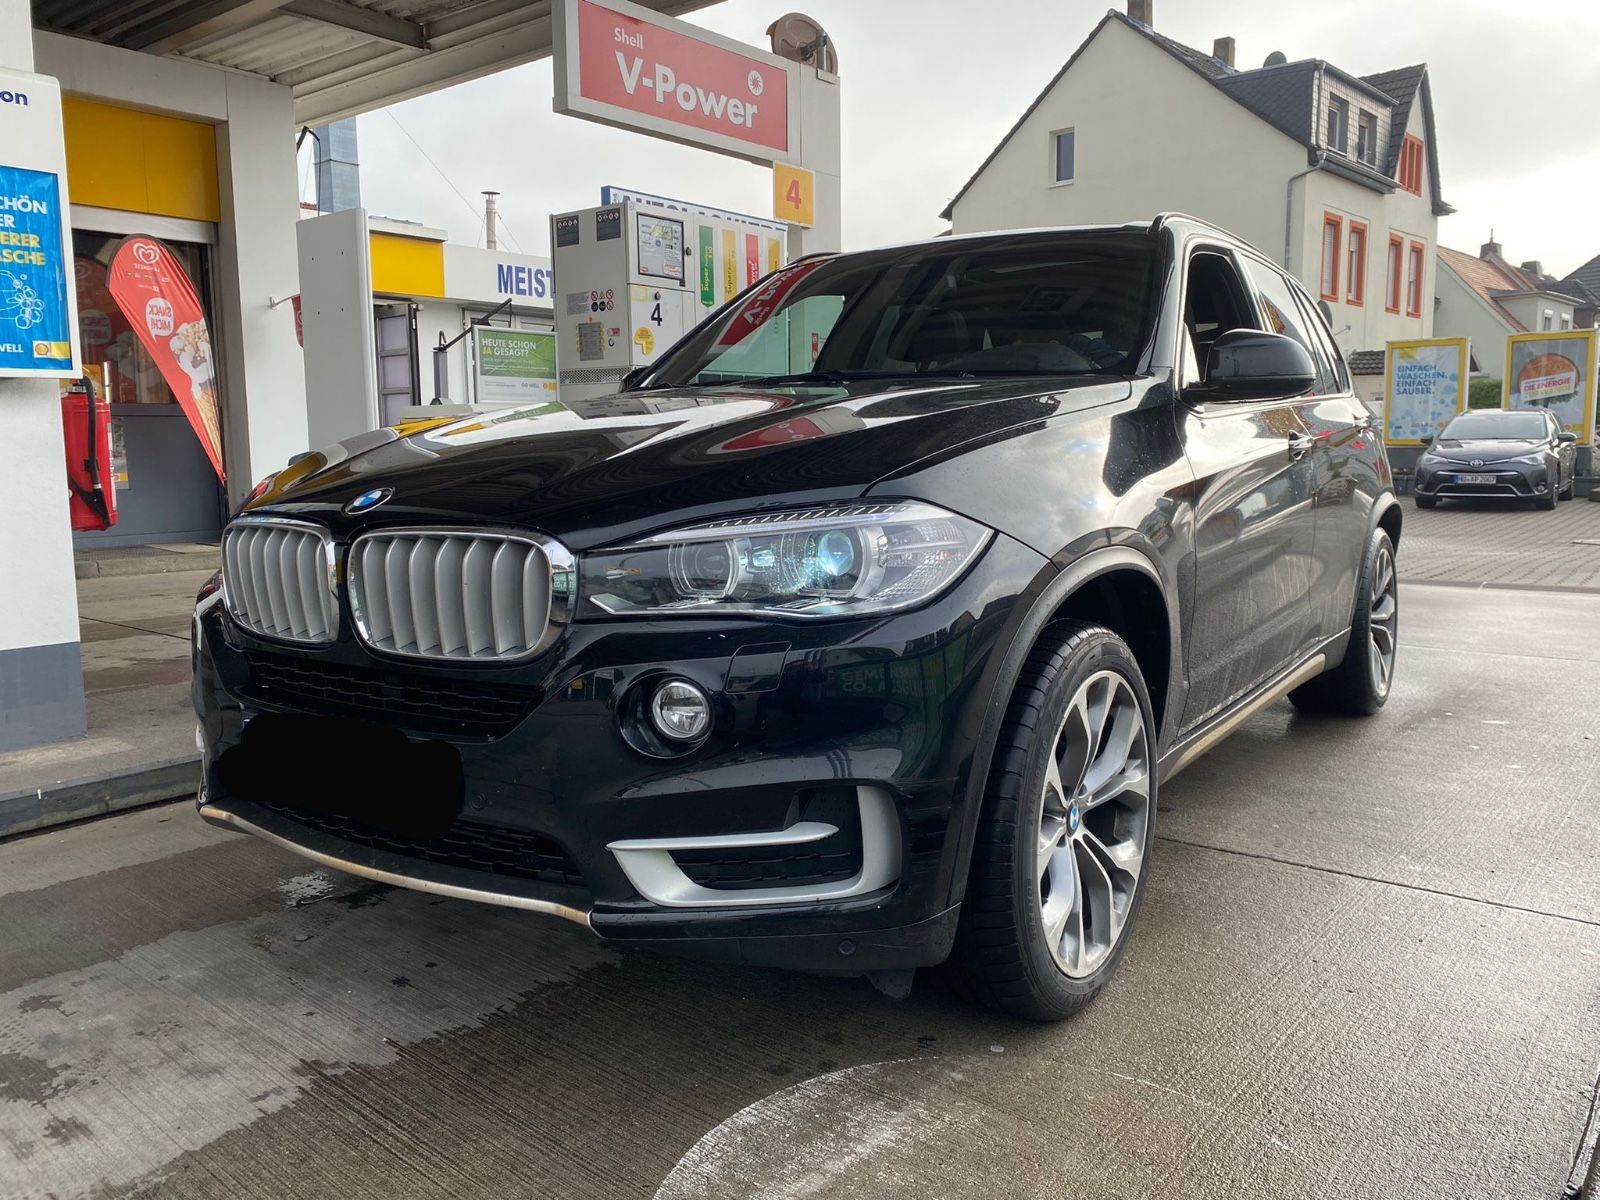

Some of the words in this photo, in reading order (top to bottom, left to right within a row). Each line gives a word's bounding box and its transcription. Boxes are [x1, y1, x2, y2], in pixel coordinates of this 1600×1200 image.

[614, 27, 643, 49] Shell
[615, 50, 758, 128] V-Power
[786, 179, 802, 209] 4
[650, 302, 662, 326] 4
[482, 338, 506, 348] HEUTE
[482, 346, 492, 355] JA
[494, 348, 529, 357] GESAGT?
[1397, 364, 1437, 373] EINFACH
[1397, 372, 1448, 380] WASCHEN.
[1537, 377, 1571, 389] ENERGIE
